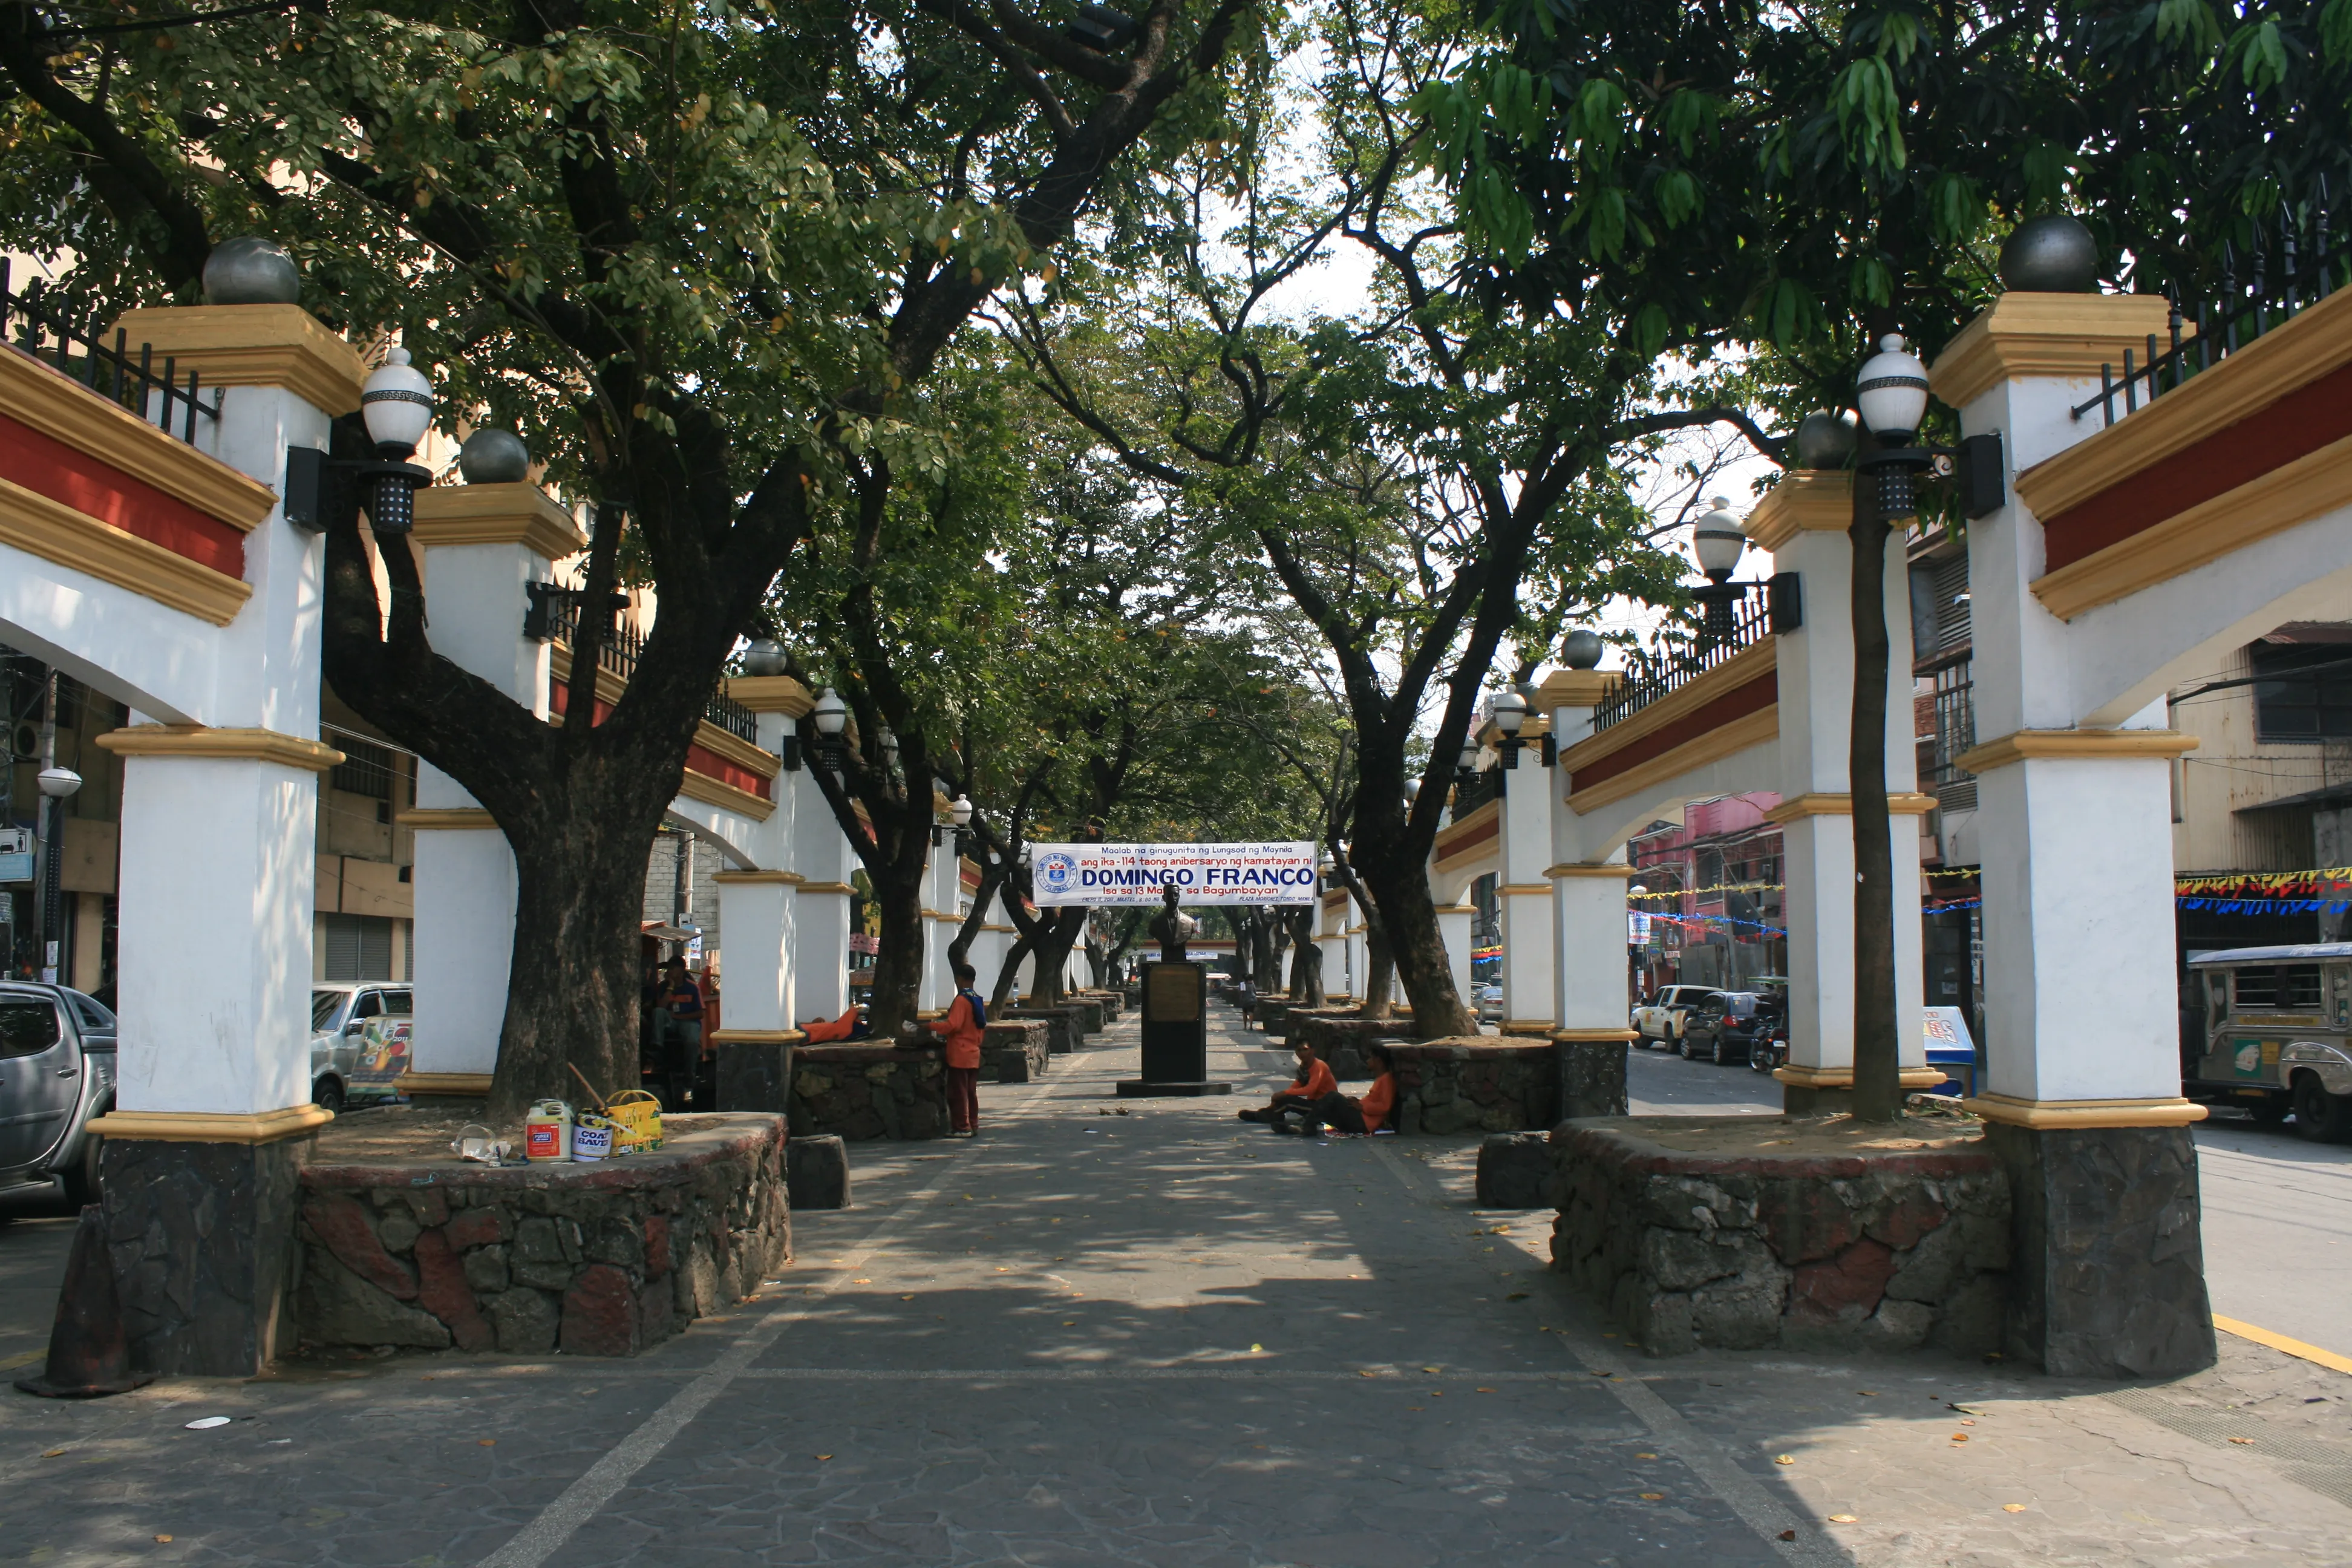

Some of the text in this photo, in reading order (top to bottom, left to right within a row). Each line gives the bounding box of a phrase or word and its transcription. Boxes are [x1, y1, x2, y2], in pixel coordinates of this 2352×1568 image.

[1212, 846, 1246, 855] Lungsod
[1263, 846, 1292, 854] Maynila
[1081, 860, 1098, 868] ang
[1139, 857, 1167, 867] taong
[1170, 856, 1227, 867] anibersaryo
[1230, 858, 1241, 867] ng
[1244, 857, 1300, 867] kamatayan
[1303, 855, 1312, 864] ni
[1082, 868, 1314, 886] DOMINGO FRANCO
[1203, 886, 1278, 896] Bagumbayan
